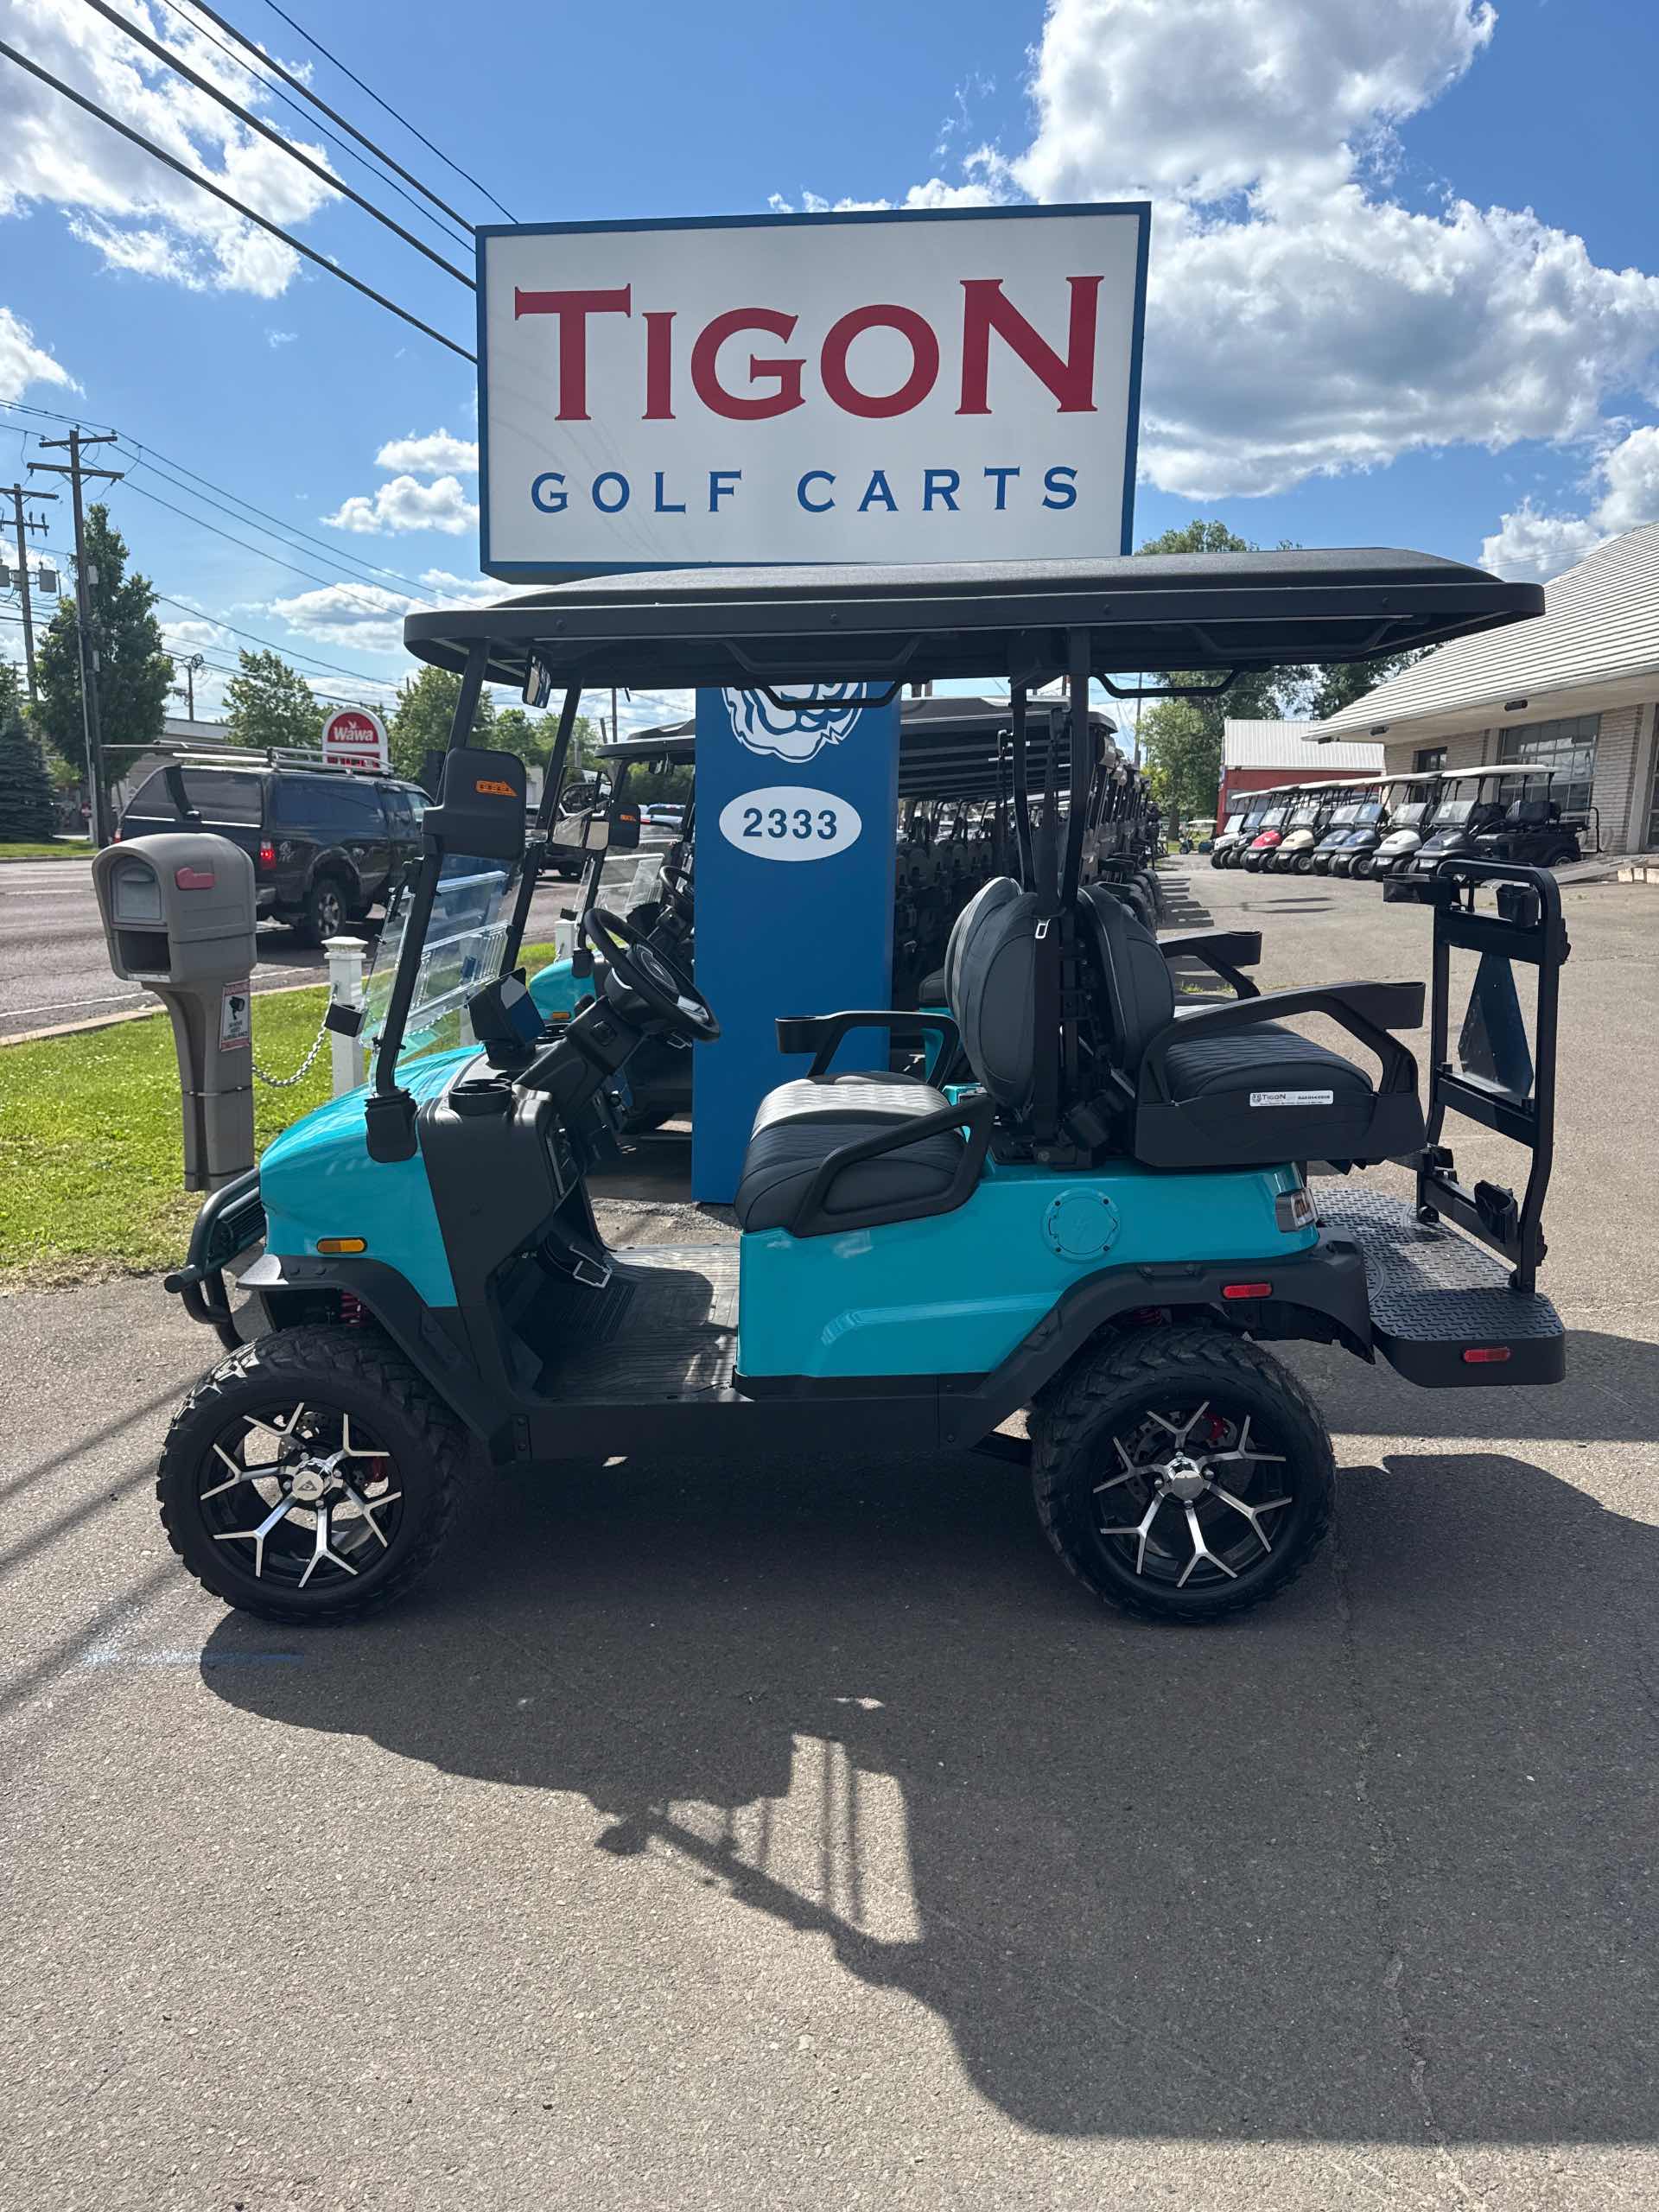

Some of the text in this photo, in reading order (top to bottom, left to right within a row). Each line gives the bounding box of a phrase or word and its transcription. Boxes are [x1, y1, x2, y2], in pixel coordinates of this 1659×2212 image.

[514, 276, 1104, 421] TIGON
[531, 466, 1078, 514] GOLF CARTS
[334, 727, 374, 741] Wawa
[742, 808, 837, 840] 2333
